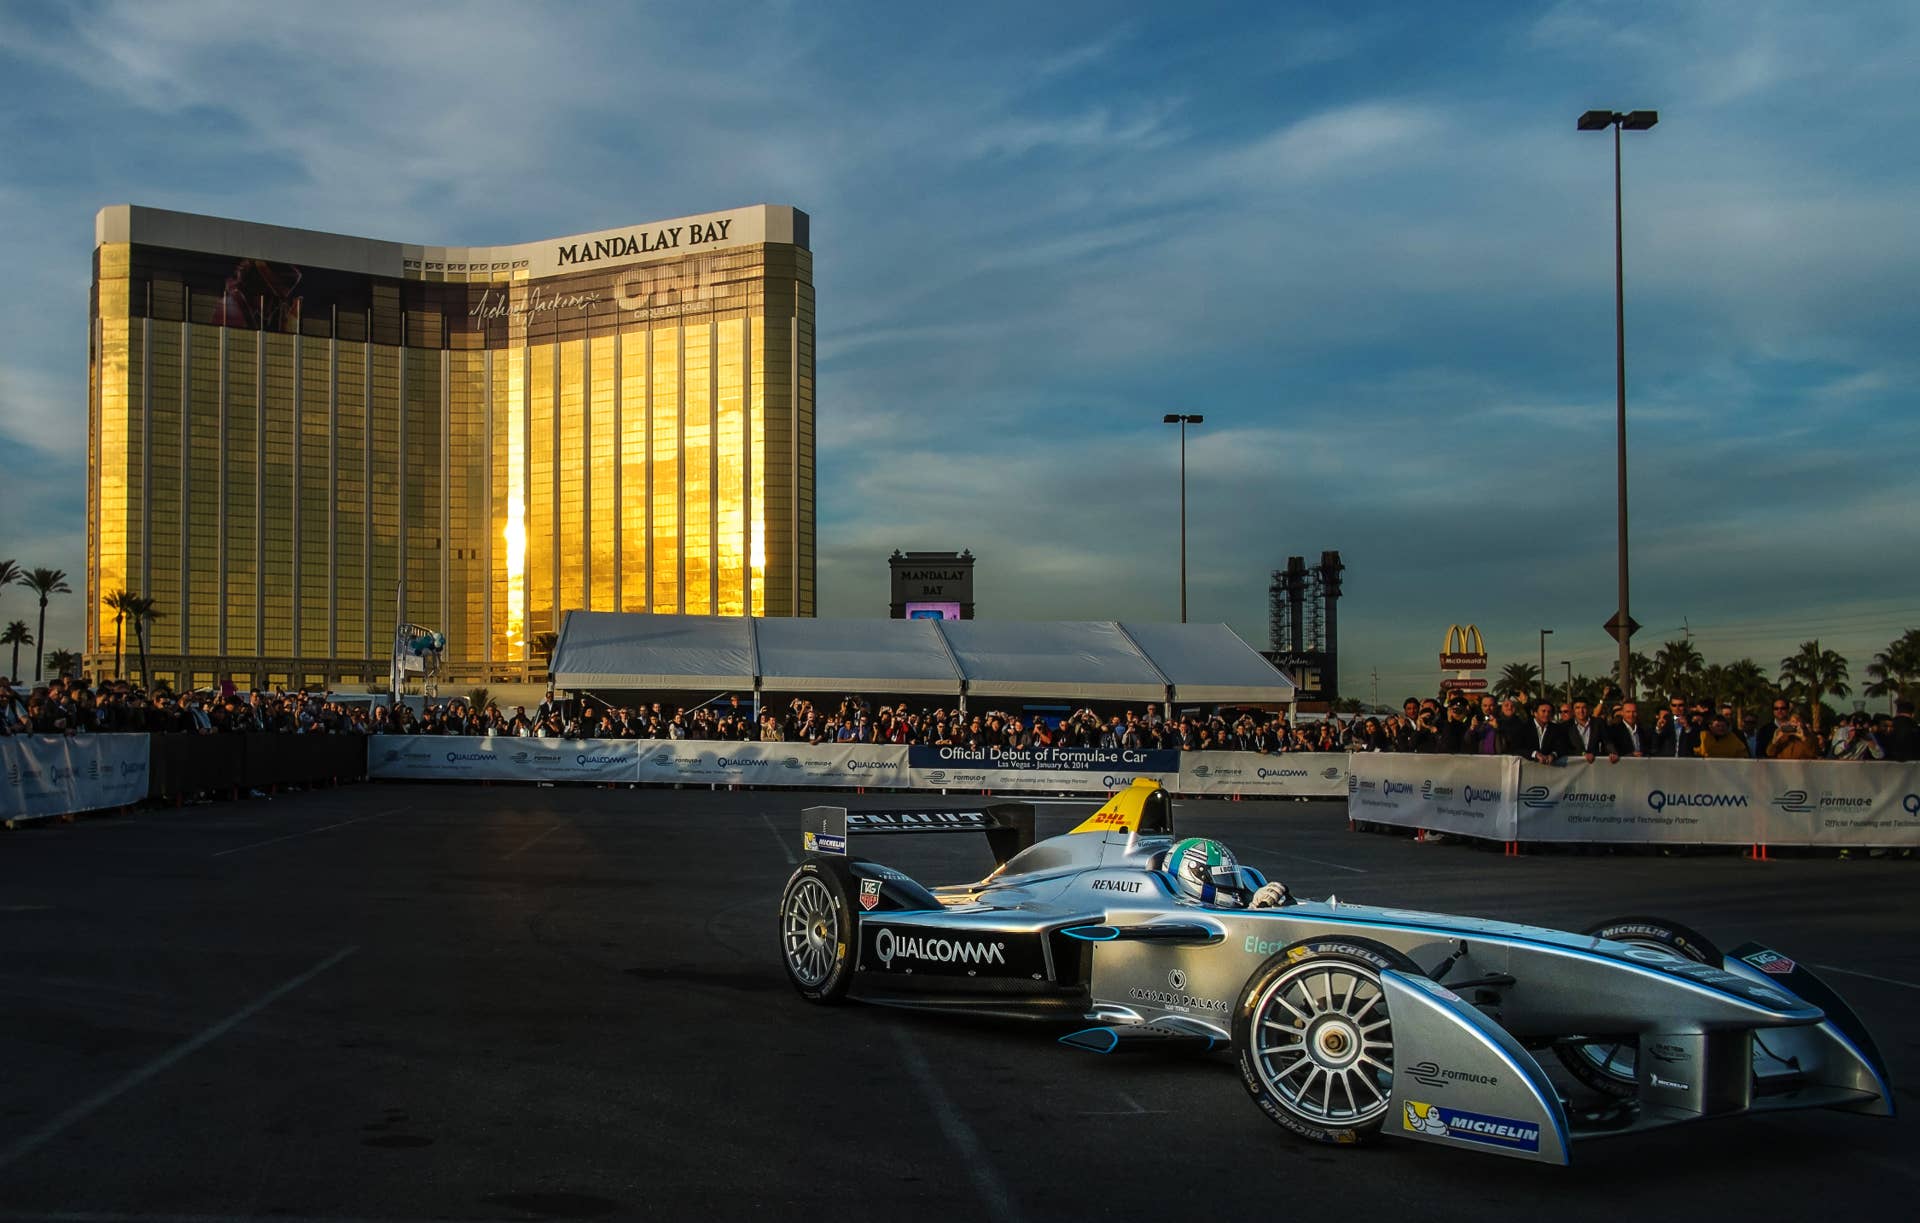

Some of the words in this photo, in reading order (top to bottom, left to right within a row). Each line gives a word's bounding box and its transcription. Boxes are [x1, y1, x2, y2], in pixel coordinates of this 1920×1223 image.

[557, 227, 683, 266] MANDALAY
[689, 219, 732, 245] BAY
[901, 571, 965, 580] MANDALAY
[922, 586, 944, 595] BAY
[446, 752, 497, 764] QUALCOMM
[576, 754, 627, 767] QUALCOMM
[939, 747, 985, 760] Official
[990, 747, 1031, 760] Debut
[1034, 748, 1049, 761] of
[1052, 748, 1118, 762] Formula-e
[1122, 750, 1148, 763] Car
[717, 757, 768, 768] QUALCOMM
[847, 760, 898, 772] QUALCOMM
[998, 760, 1009, 768] Las
[1010, 761, 1031, 769] Vegas
[1037, 761, 1062, 770] January
[1257, 768, 1308, 780] QUALCOMM
[1648, 790, 1748, 813] QUALCOMM
[1820, 797, 1872, 807] Formula-e
[1095, 813, 1125, 825] DHL
[1567, 816, 1591, 824] Official
[864, 882, 877, 894] TAG
[1091, 879, 1143, 893] RENAULT
[1601, 926, 1670, 938] MICHELIN
[875, 928, 1005, 968] QUALCOMM
[1317, 944, 1390, 968] MICHELIN
[1129, 987, 1180, 1005] CAESARS
[1182, 995, 1229, 1013] PALACE
[1441, 1069, 1498, 1086] Formula-e
[1450, 1117, 1538, 1140] MICHELIN
